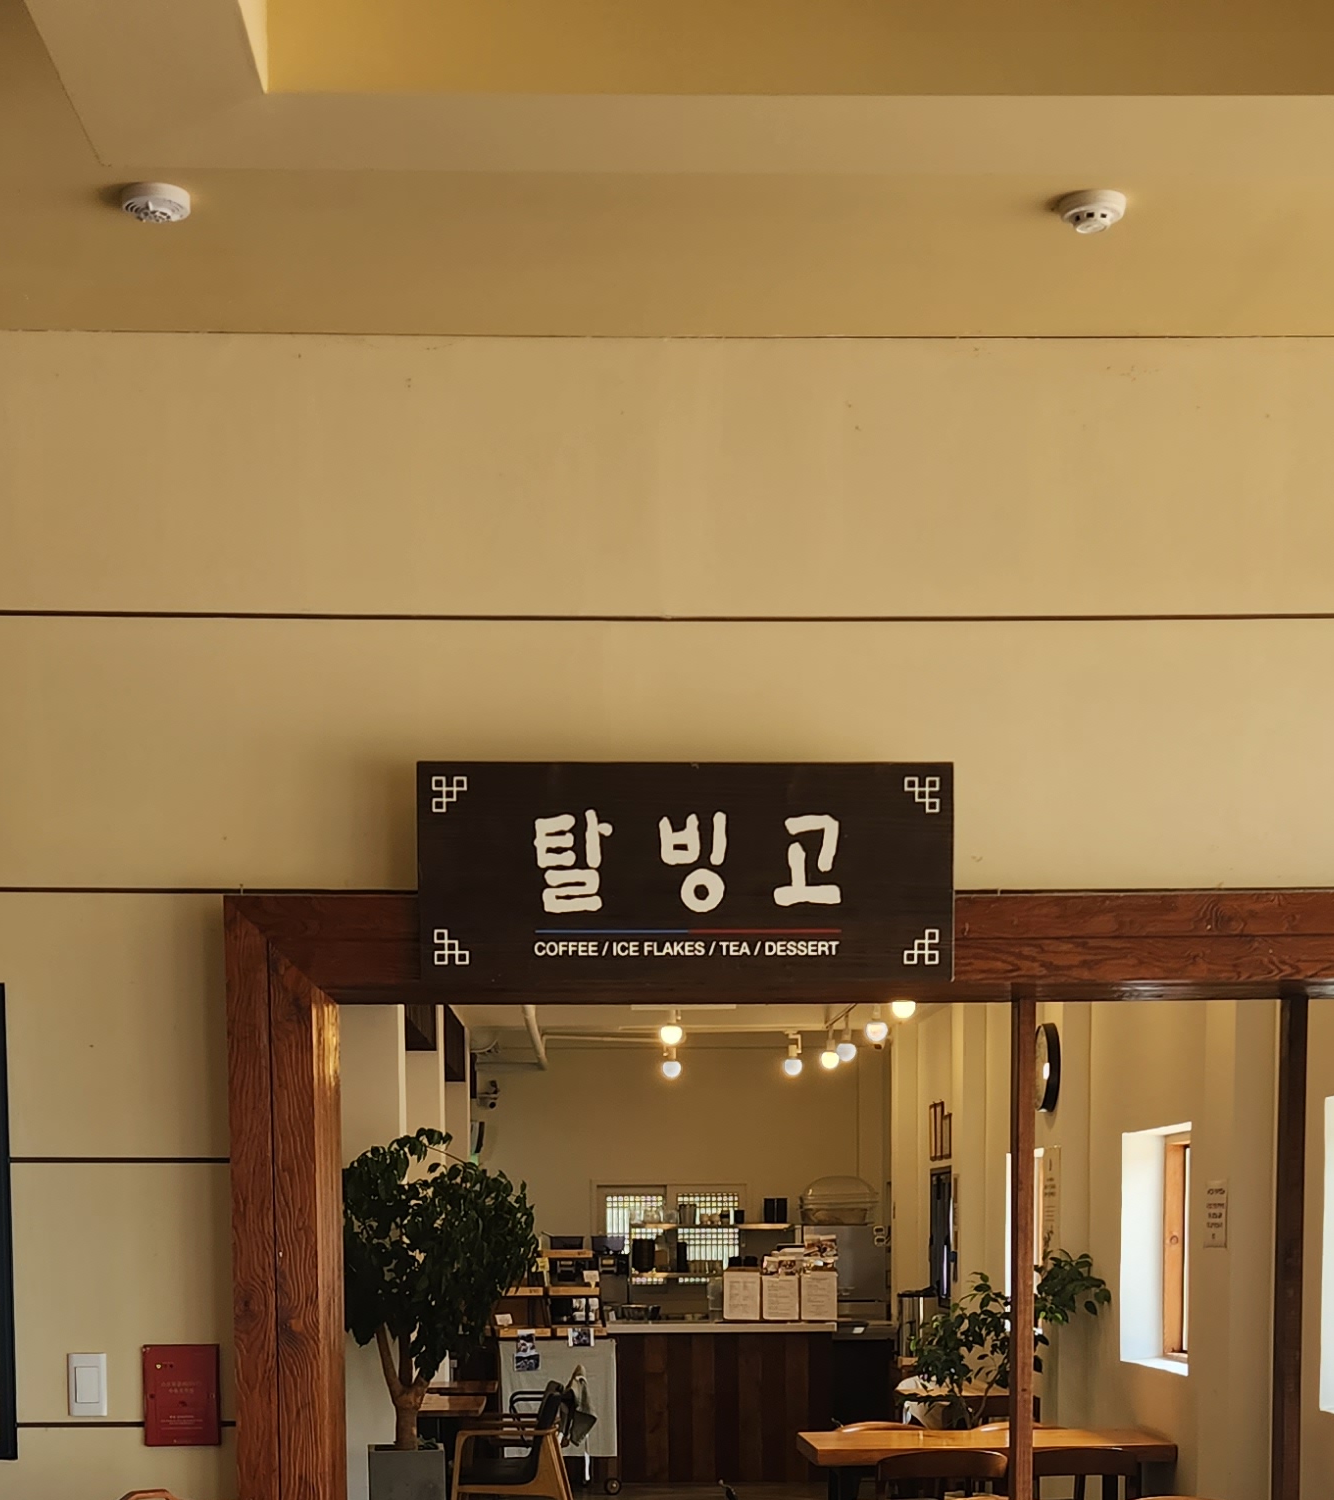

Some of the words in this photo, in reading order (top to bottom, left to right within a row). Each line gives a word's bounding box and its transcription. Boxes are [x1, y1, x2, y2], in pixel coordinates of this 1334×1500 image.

[534, 941, 598, 958] COFFEE
[612, 941, 639, 958] ICE
[643, 941, 705, 958] FLAKES
[719, 941, 751, 958] TEA
[764, 941, 839, 958] DESSERT
